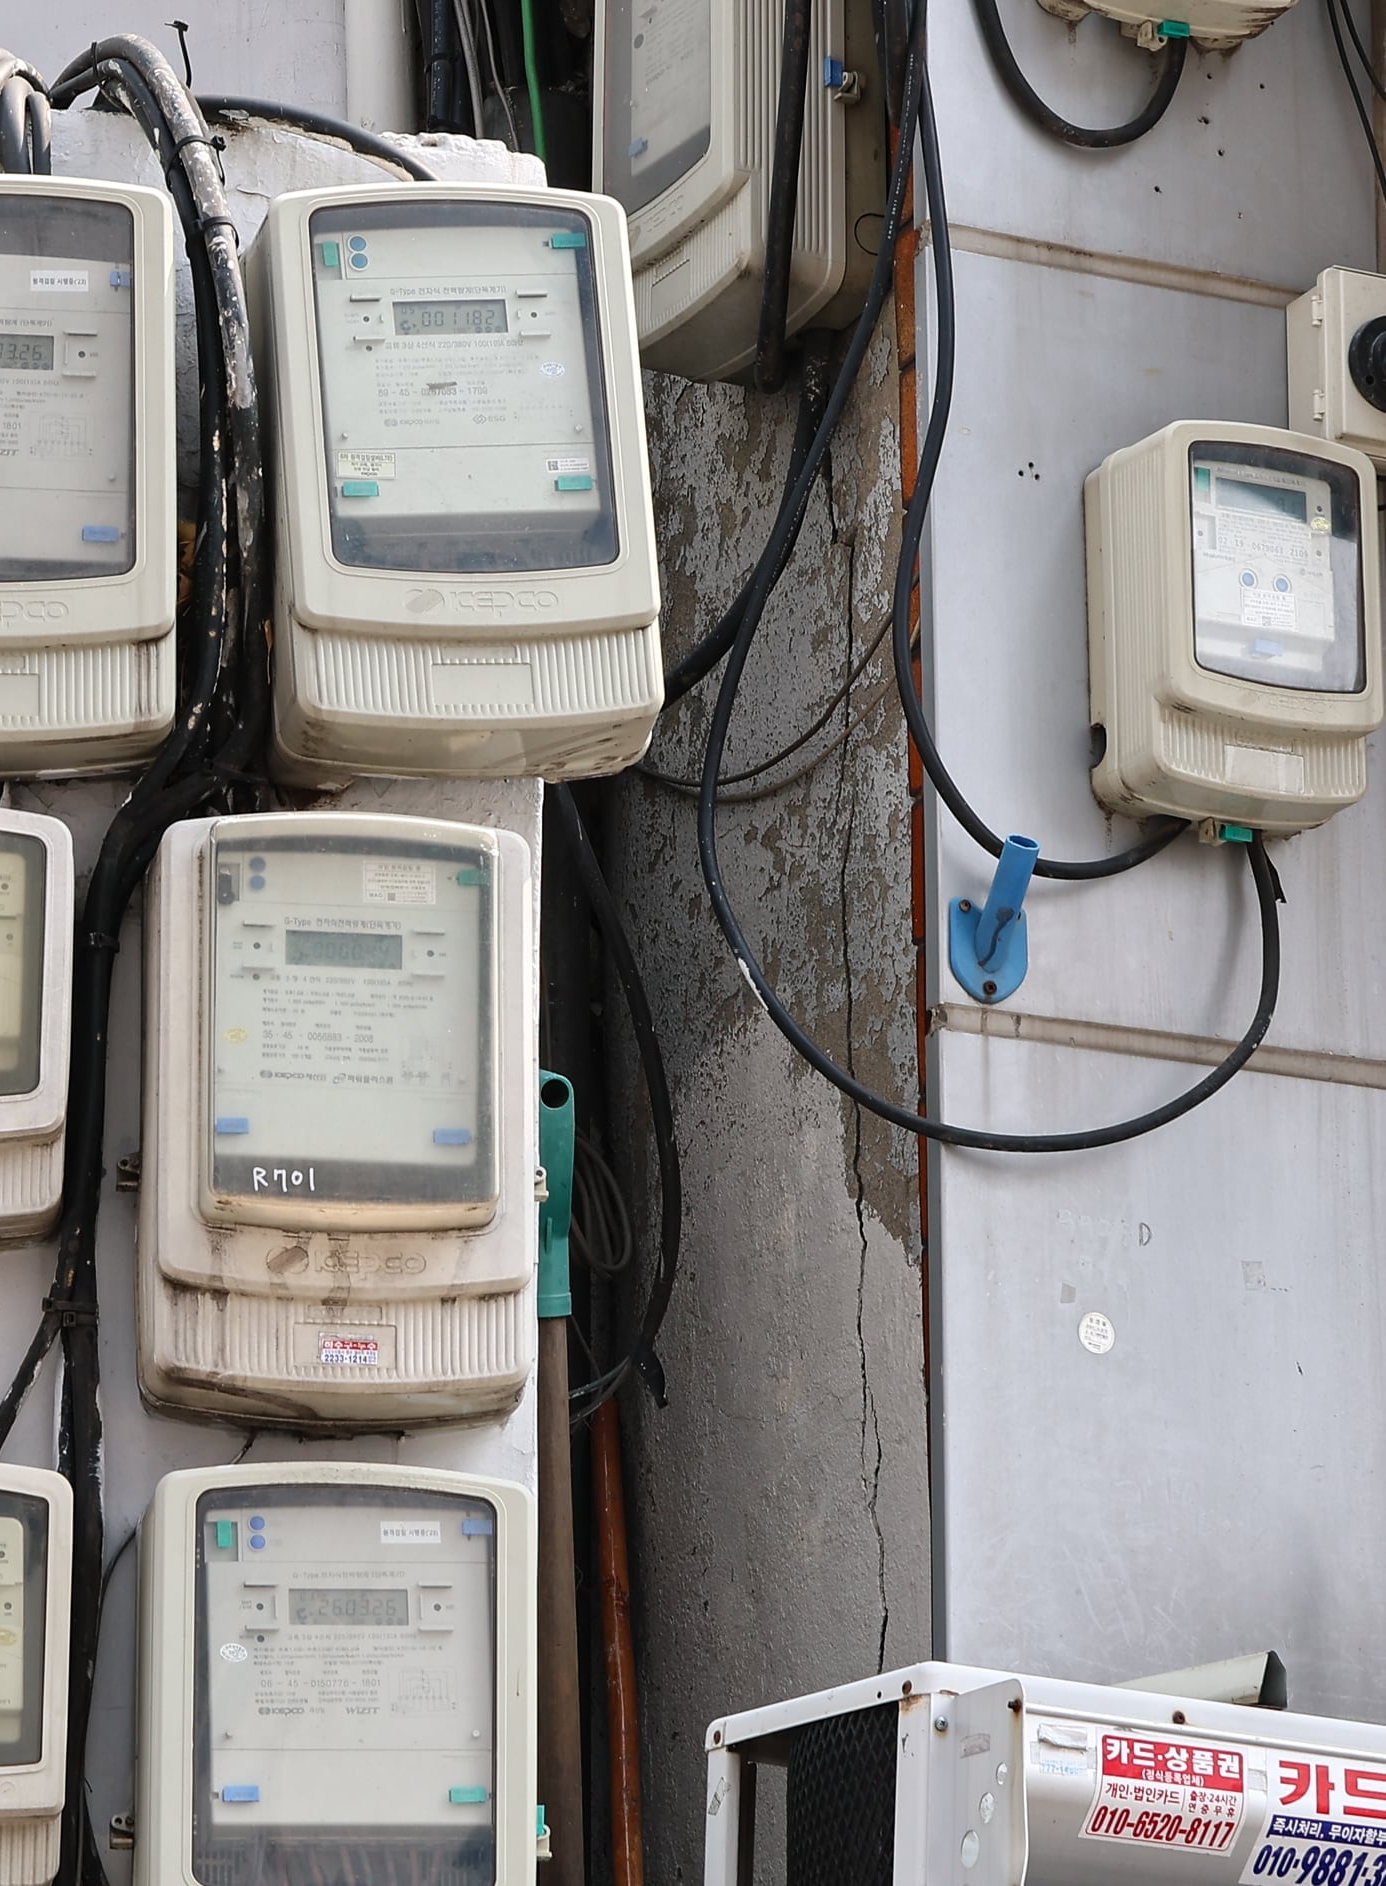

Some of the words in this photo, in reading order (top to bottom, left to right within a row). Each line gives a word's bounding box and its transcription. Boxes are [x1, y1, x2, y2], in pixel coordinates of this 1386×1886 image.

[253, 1167, 316, 1191] R701
[1105, 1737, 1240, 1779] 카드·상품권
[1141, 1771, 1205, 1787] (정식등록업체)
[1104, 1782, 1181, 1805] 개인·법인카드
[1190, 1792, 1237, 1806] 출장·24시간
[1090, 1805, 1235, 1848] 010-6520-8117
[1272, 1817, 1324, 1839] 즉시처리,
